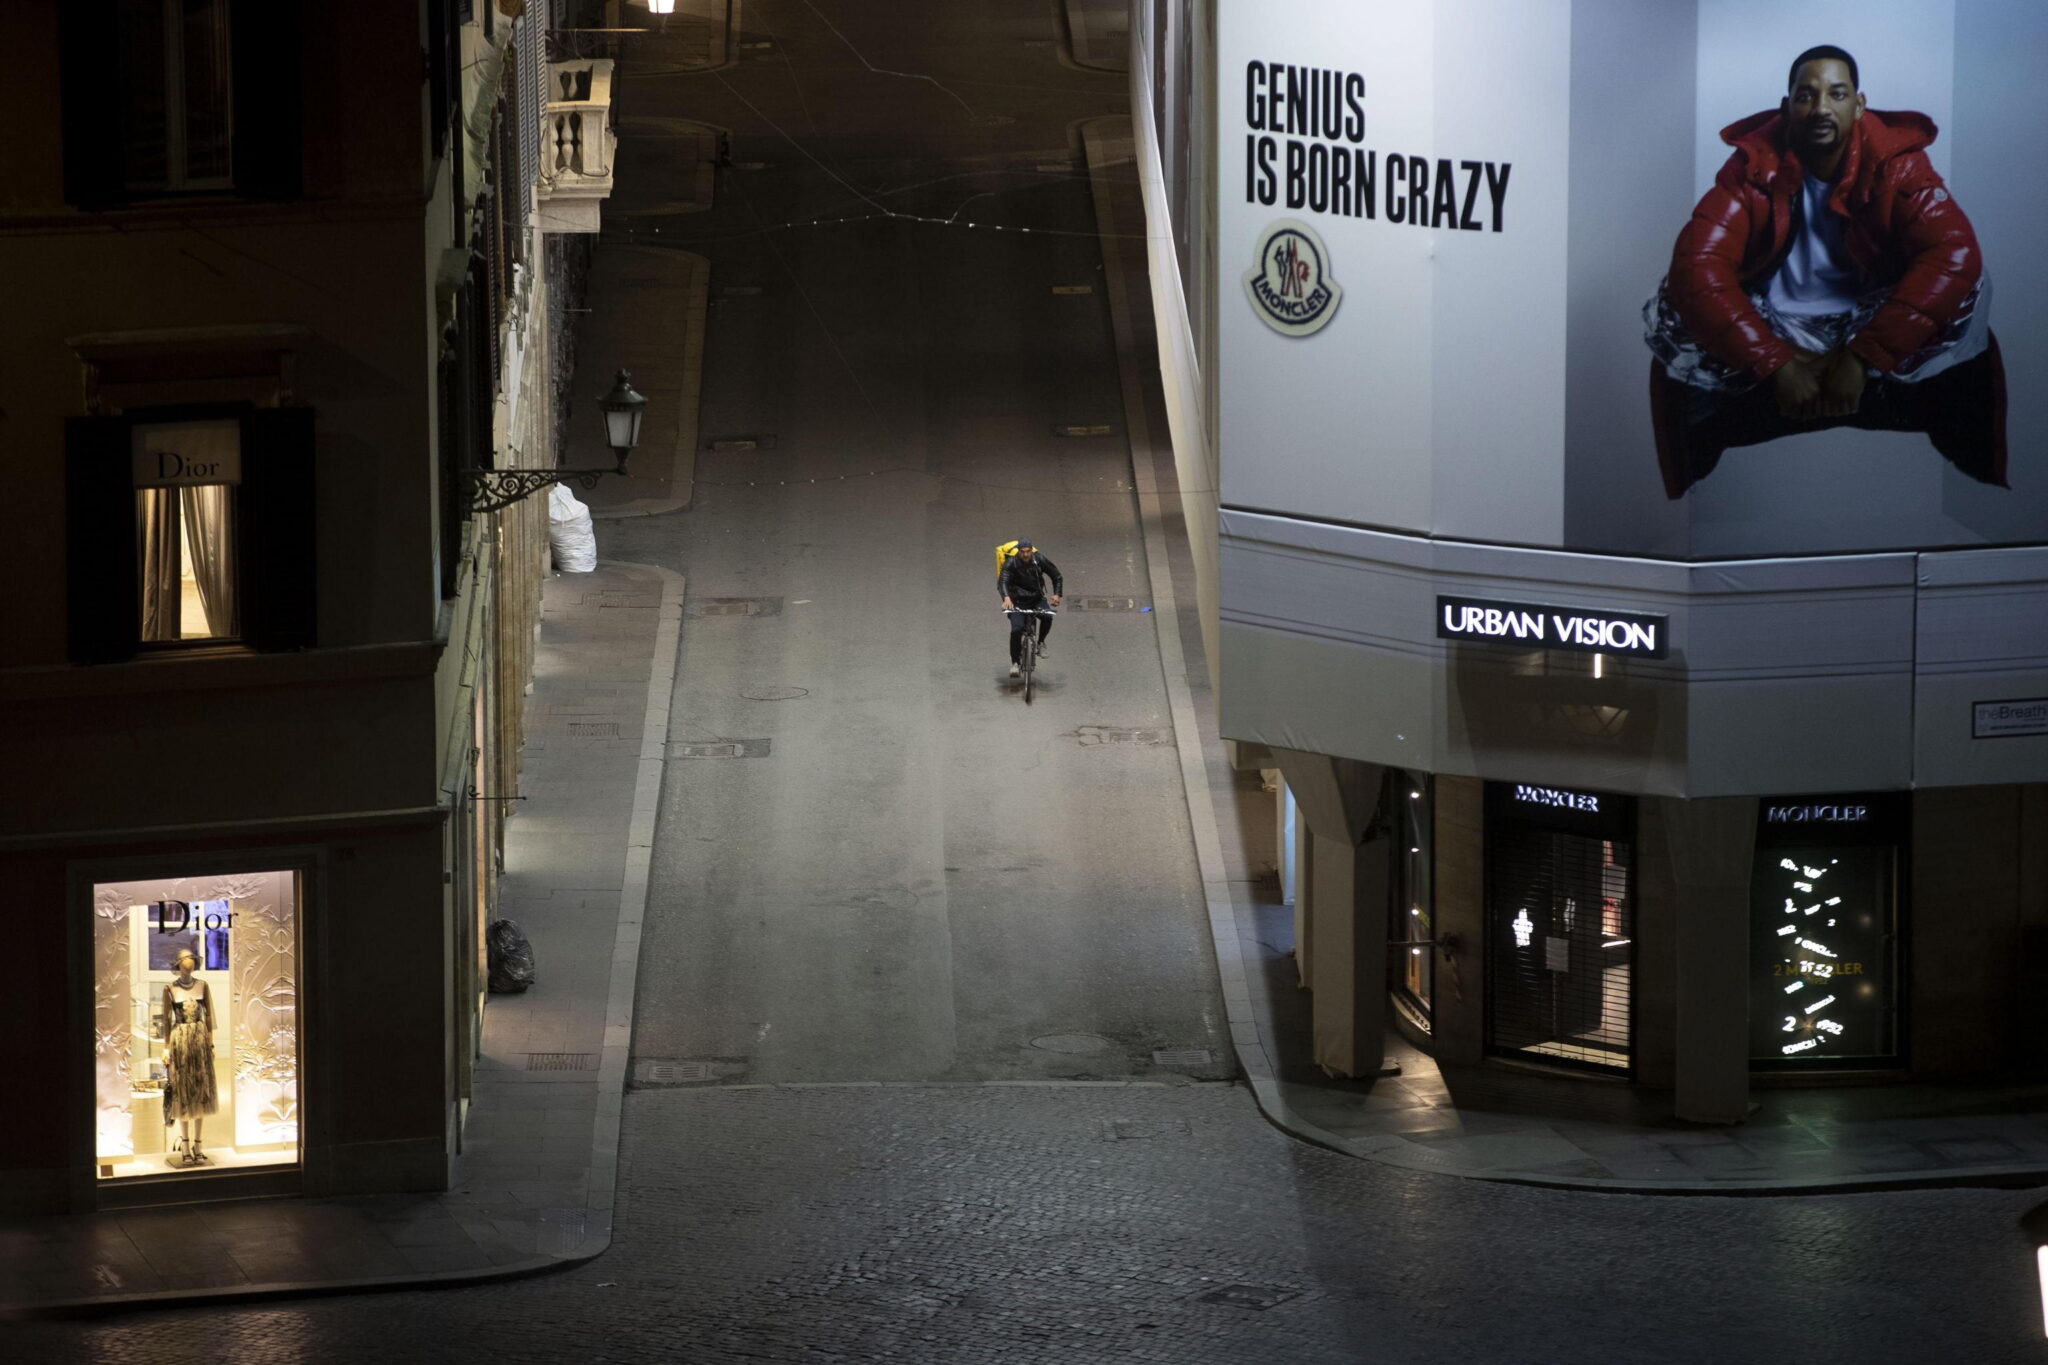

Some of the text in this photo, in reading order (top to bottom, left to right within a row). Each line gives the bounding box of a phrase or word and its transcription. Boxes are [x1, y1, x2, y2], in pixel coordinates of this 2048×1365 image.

[1246, 60, 1365, 143] GENIUS
[1246, 134, 1512, 232] IS BORN CRAZY
[1258, 281, 1325, 317] MONCLER
[157, 452, 220, 480] Dior
[1445, 604, 1655, 651] URBAN VISION
[1515, 785, 1599, 812] MONCLER
[1768, 805, 1867, 823] MONCLER
[157, 900, 239, 935] Dior
[1782, 1016, 1797, 1032] 2
